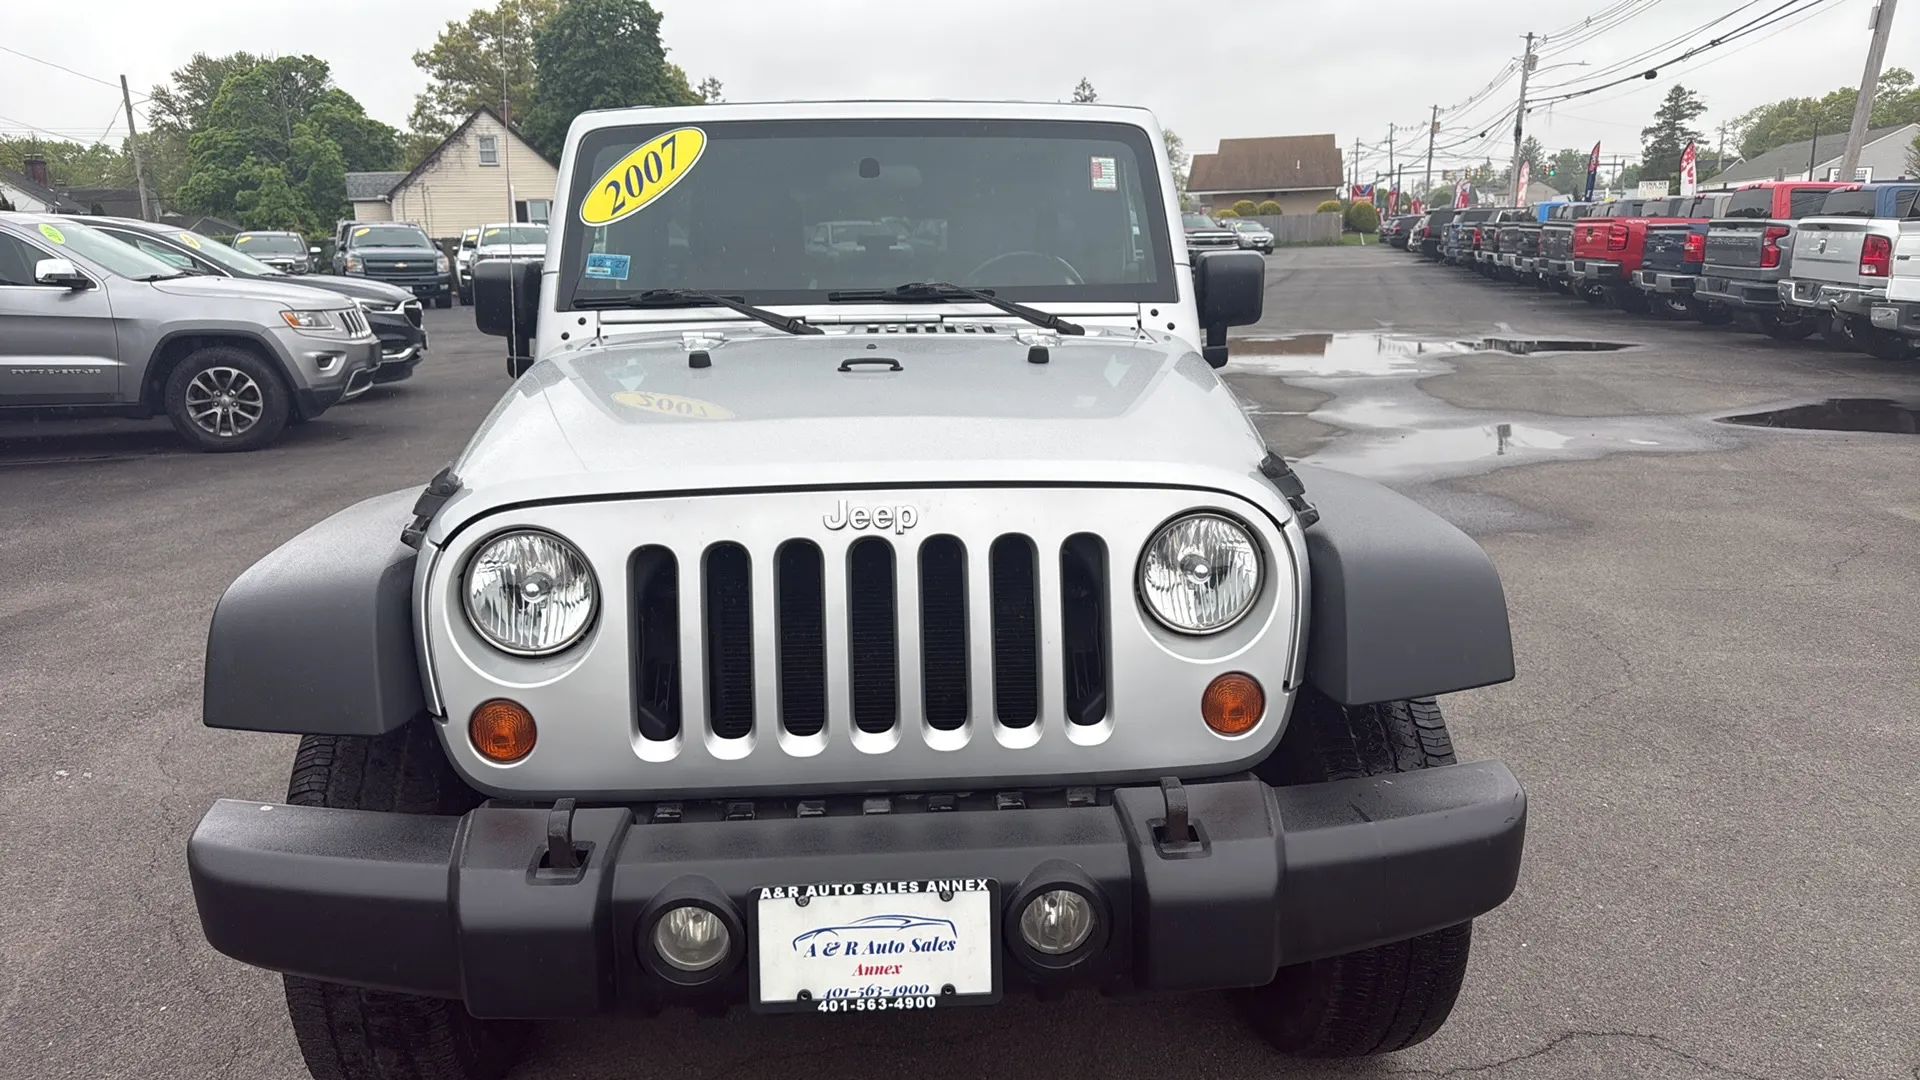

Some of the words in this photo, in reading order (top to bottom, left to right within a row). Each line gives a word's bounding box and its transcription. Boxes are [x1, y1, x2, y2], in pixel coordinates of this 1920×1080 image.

[604, 133, 677, 217] 2007
[823, 499, 918, 535] Jeep
[759, 886, 800, 900] A&R
[806, 883, 856, 897] AUTO
[862, 881, 920, 895] SALES
[926, 878, 988, 892] ANNEX
[804, 942, 817, 958] A
[822, 942, 841, 956] &
[844, 941, 859, 956] R
[863, 939, 905, 956] Auto
[909, 936, 957, 953] Sales
[852, 963, 903, 977] Annex
[822, 983, 930, 1000] 401-563-4900
[817, 997, 937, 1013] 401-563-4900
